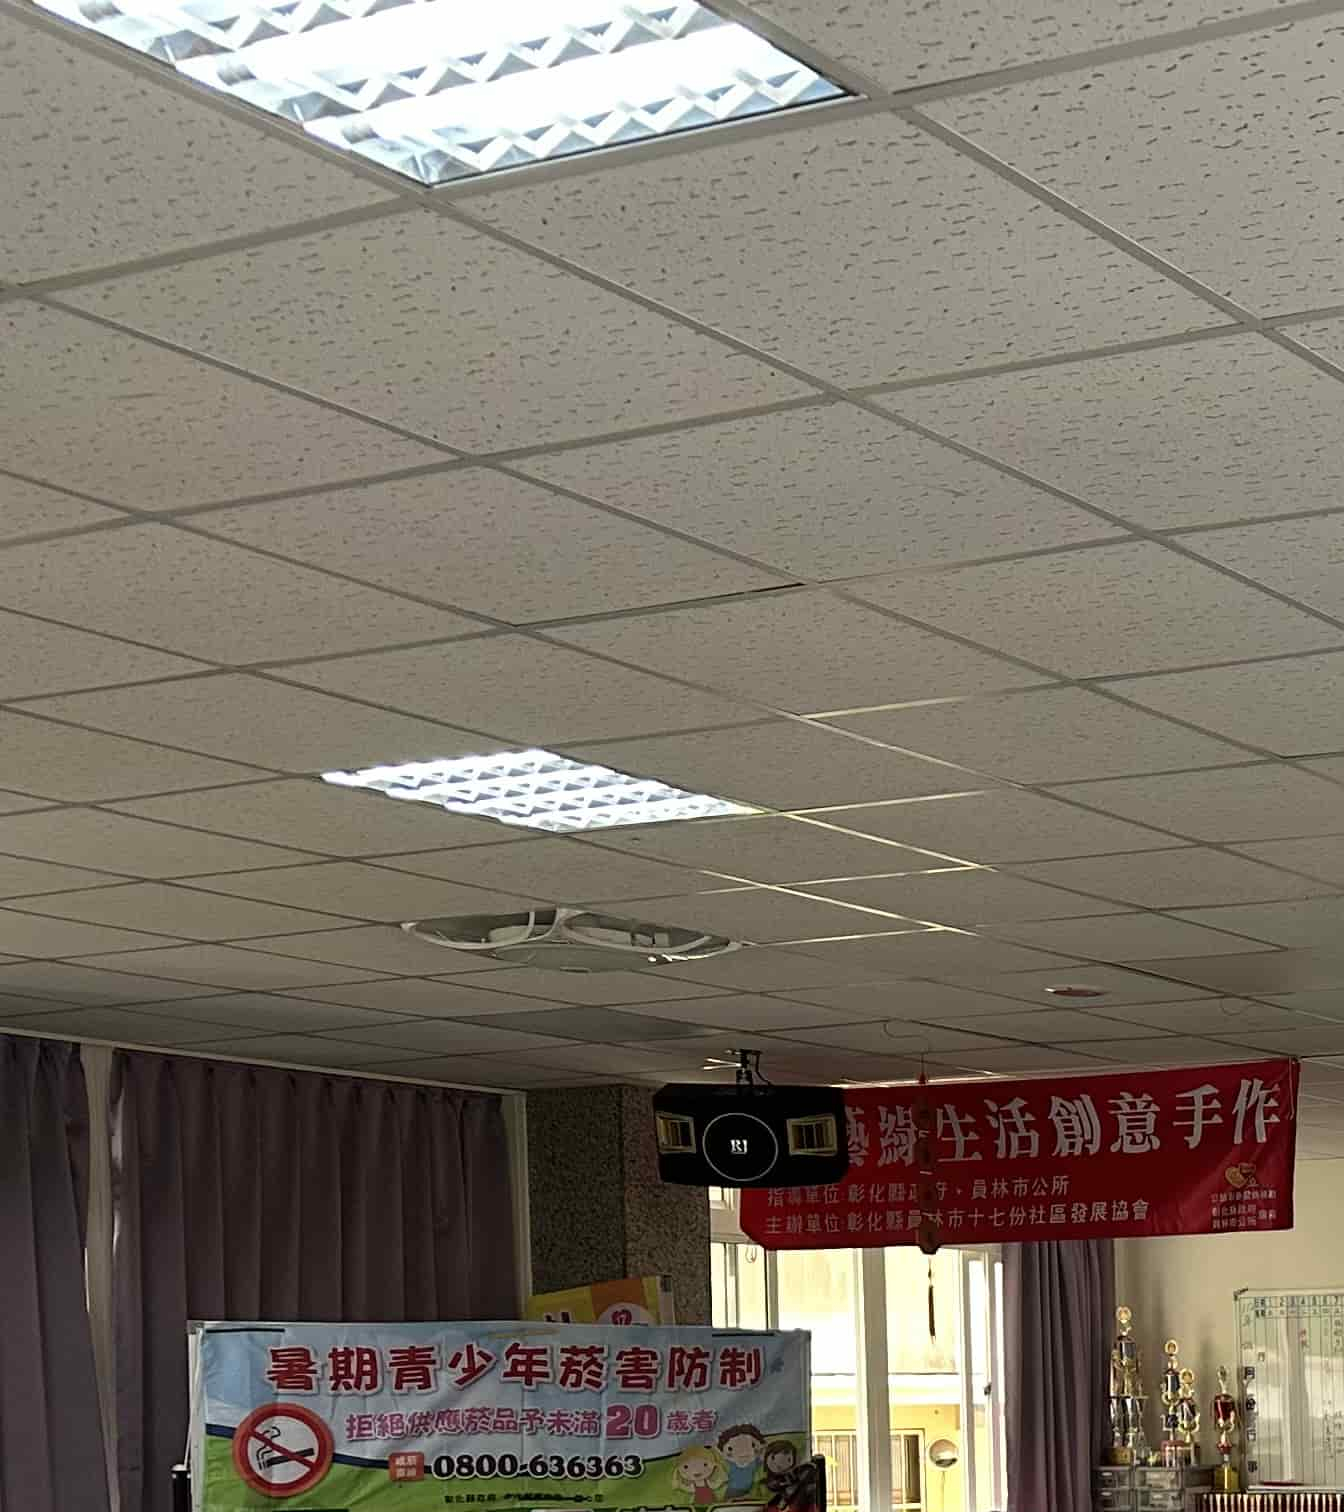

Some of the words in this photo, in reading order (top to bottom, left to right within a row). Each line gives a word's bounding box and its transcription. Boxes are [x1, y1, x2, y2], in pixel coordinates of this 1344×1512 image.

[266, 1342, 764, 1394] 暑期青少年菸害防制
[431, 1454, 644, 1481] 0800-636363
